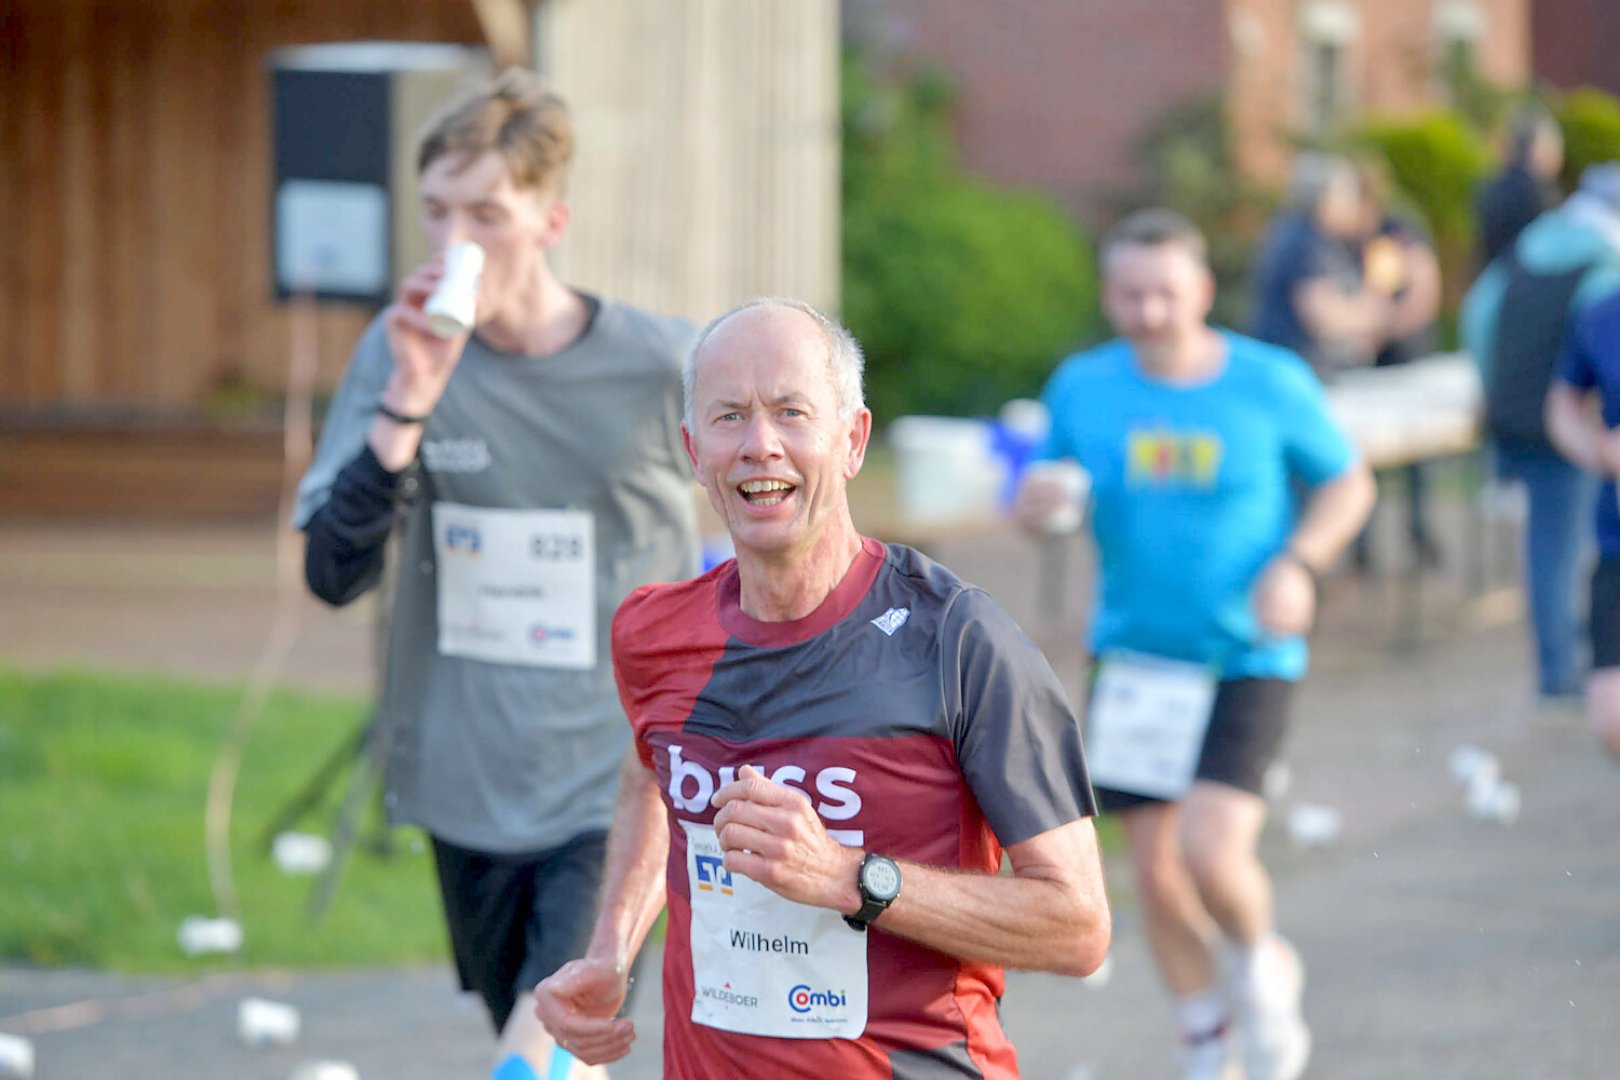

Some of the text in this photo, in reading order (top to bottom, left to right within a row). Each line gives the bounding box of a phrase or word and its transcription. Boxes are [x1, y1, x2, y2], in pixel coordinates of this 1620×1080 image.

[730, 929, 809, 955] Wilhelm
[701, 986, 758, 1007] WILDEBOER
[788, 984, 846, 1013] Combi
